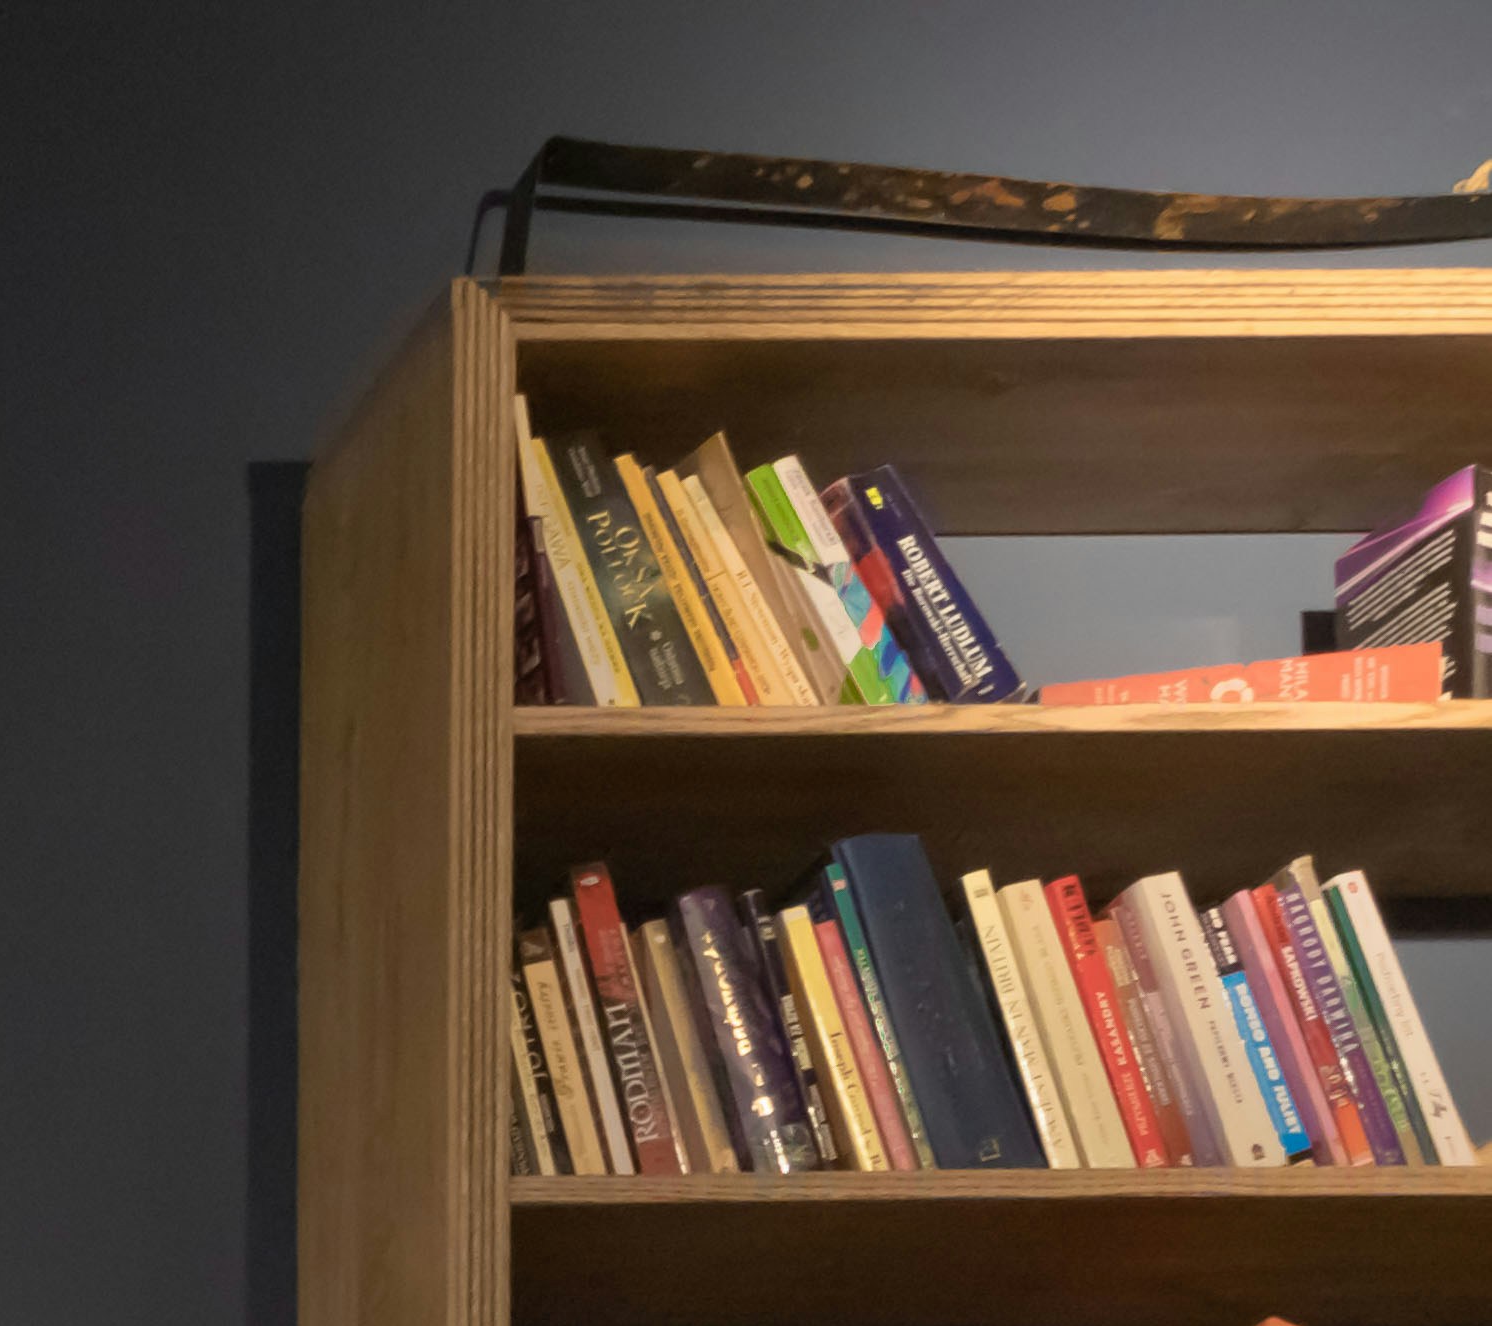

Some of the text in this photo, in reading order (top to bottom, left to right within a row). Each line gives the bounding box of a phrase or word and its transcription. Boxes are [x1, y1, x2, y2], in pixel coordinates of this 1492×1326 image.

[585, 506, 654, 631] POLLOCK
[609, 522, 661, 604] OKSA
[893, 531, 996, 680] ROBERT LUDLUM
[979, 921, 1017, 995] BRITAIN
[1156, 890, 1215, 1012] JOHN GREEN
[1274, 944, 1323, 1023] SAPKOWSKI
[1280, 889, 1363, 1055] NAGRODY DARWINA
[1005, 998, 1025, 1021] IN
[1011, 1020, 1041, 1068] MAN
[1092, 989, 1131, 1067] KASANDRY
[1229, 981, 1304, 1137] ROMEO AND JULIET
[601, 1000, 661, 1145] RODMAN
